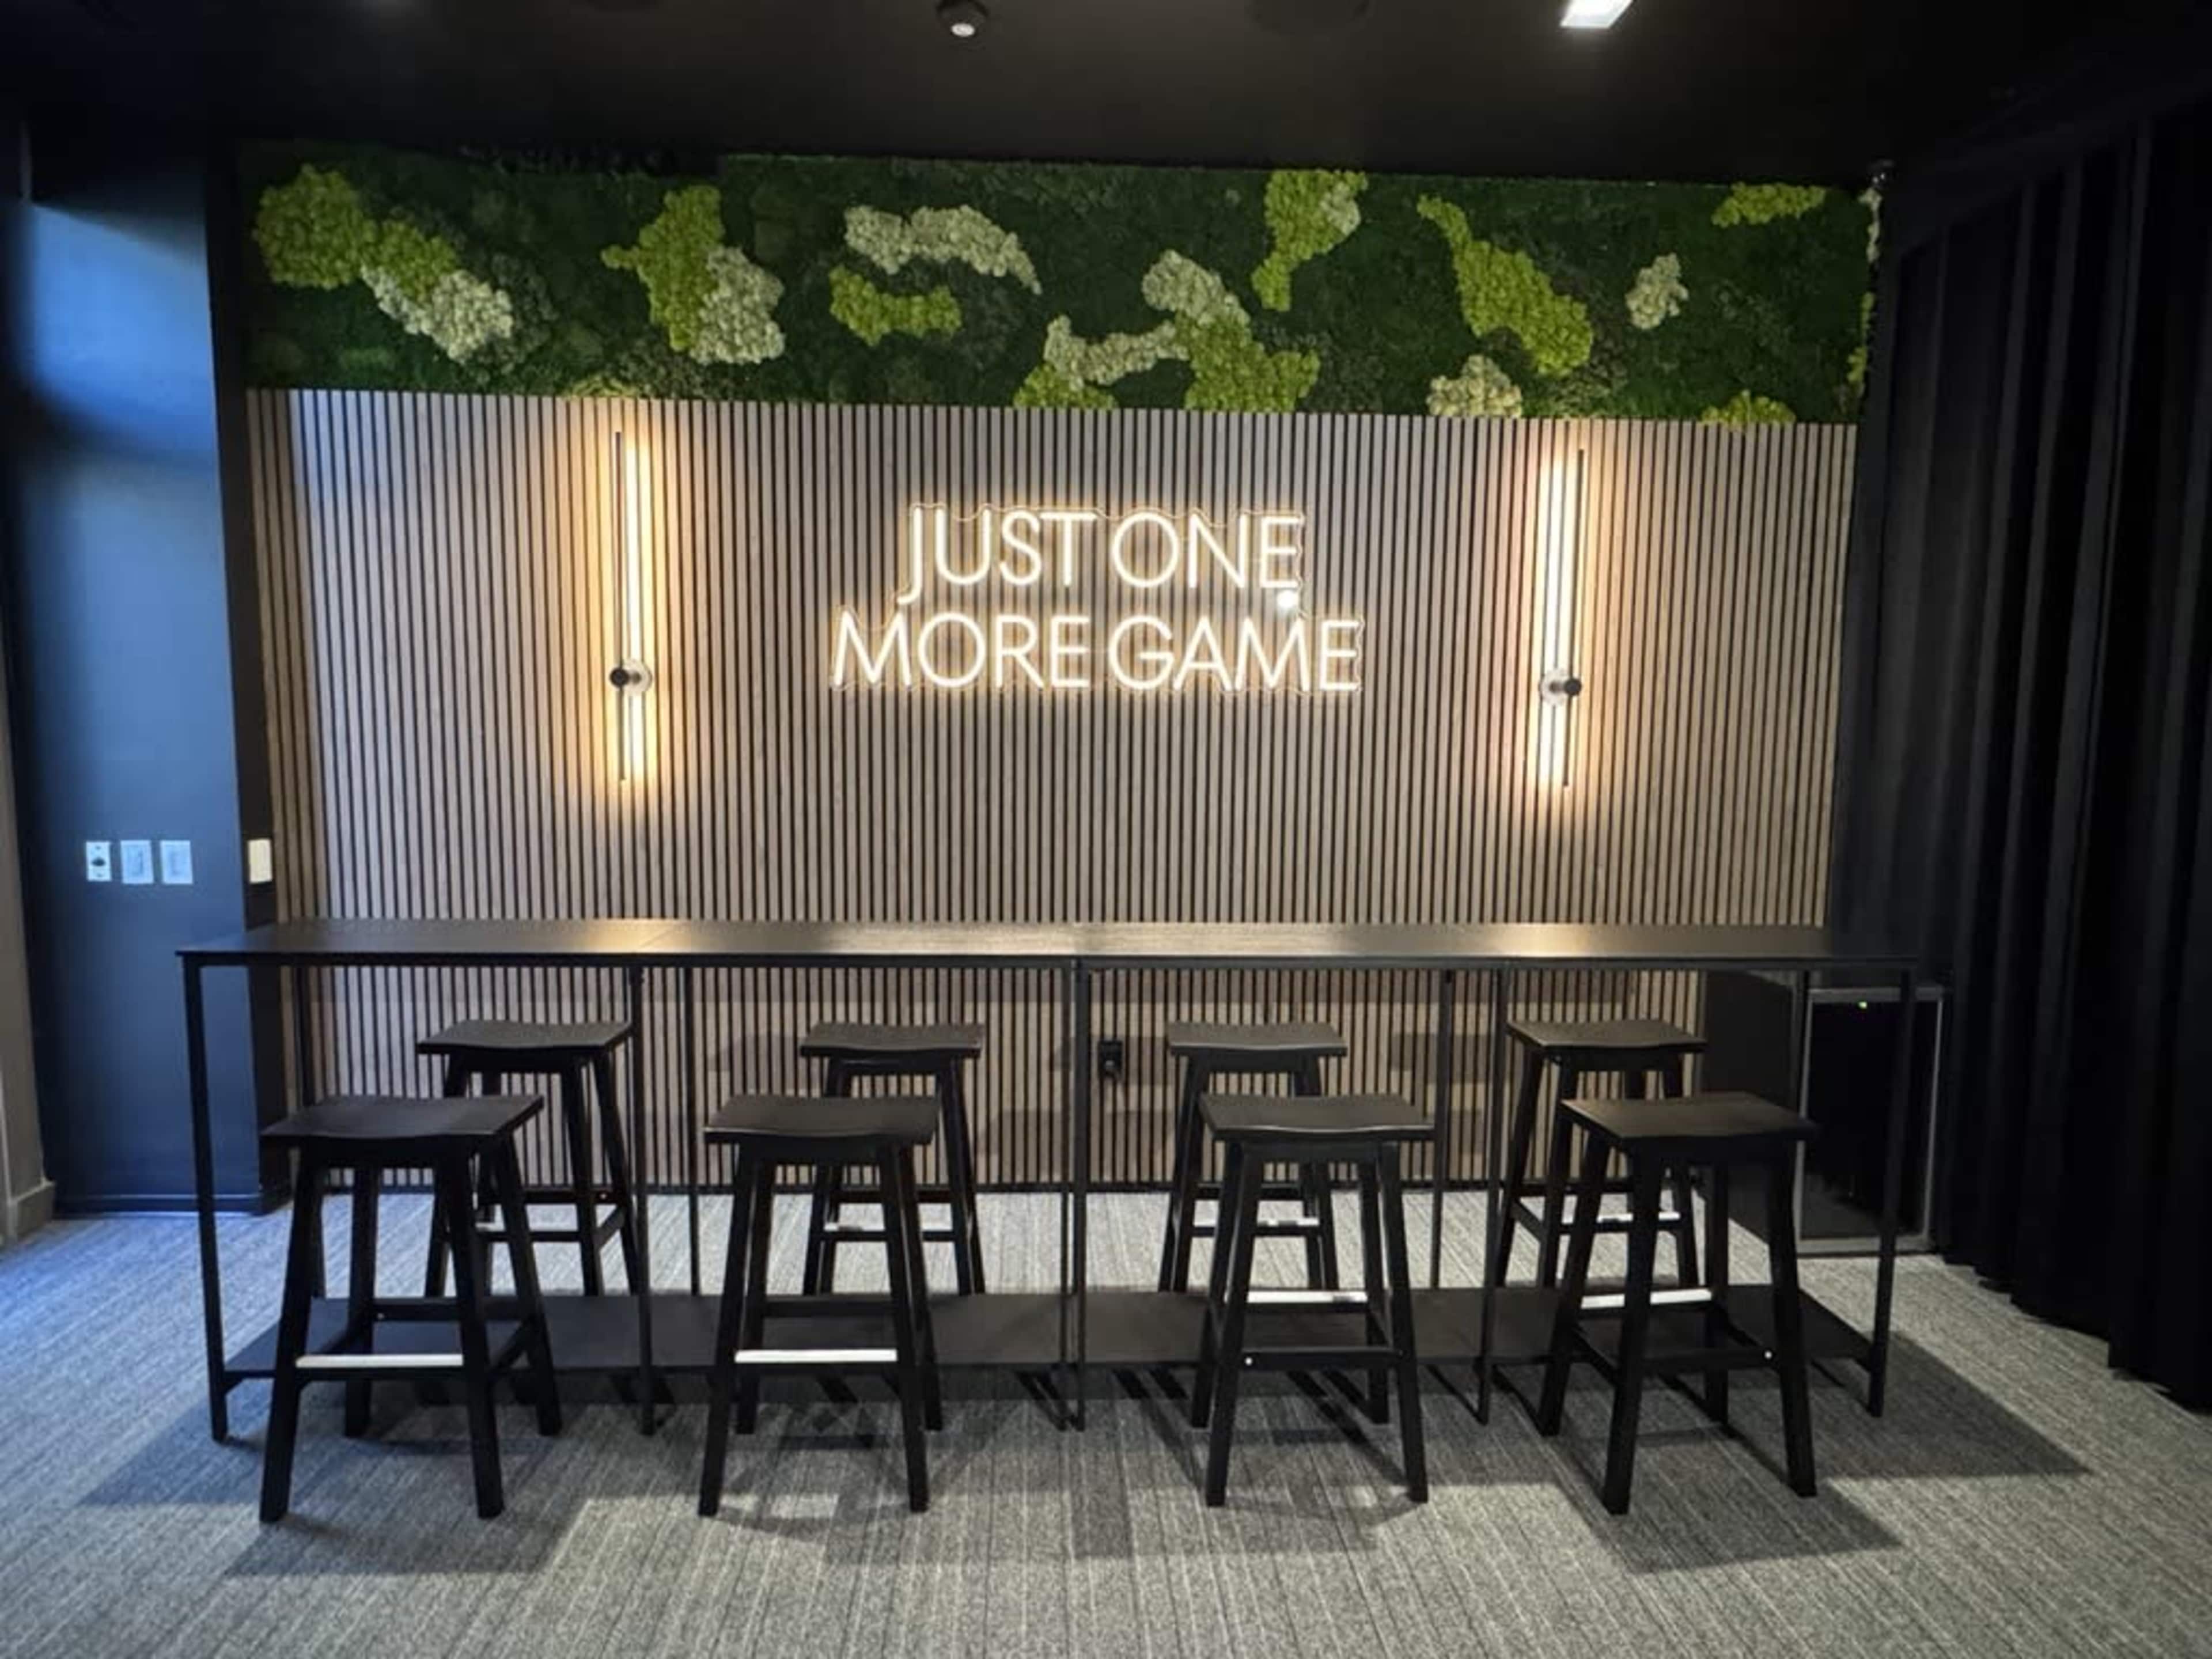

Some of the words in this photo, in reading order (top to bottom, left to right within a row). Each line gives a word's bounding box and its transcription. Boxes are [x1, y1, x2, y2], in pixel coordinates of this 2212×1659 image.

[897, 507, 1097, 605] JUST
[1111, 512, 1299, 589] ONE
[833, 611, 1090, 688] MORE
[1108, 616, 1359, 691] GAME
